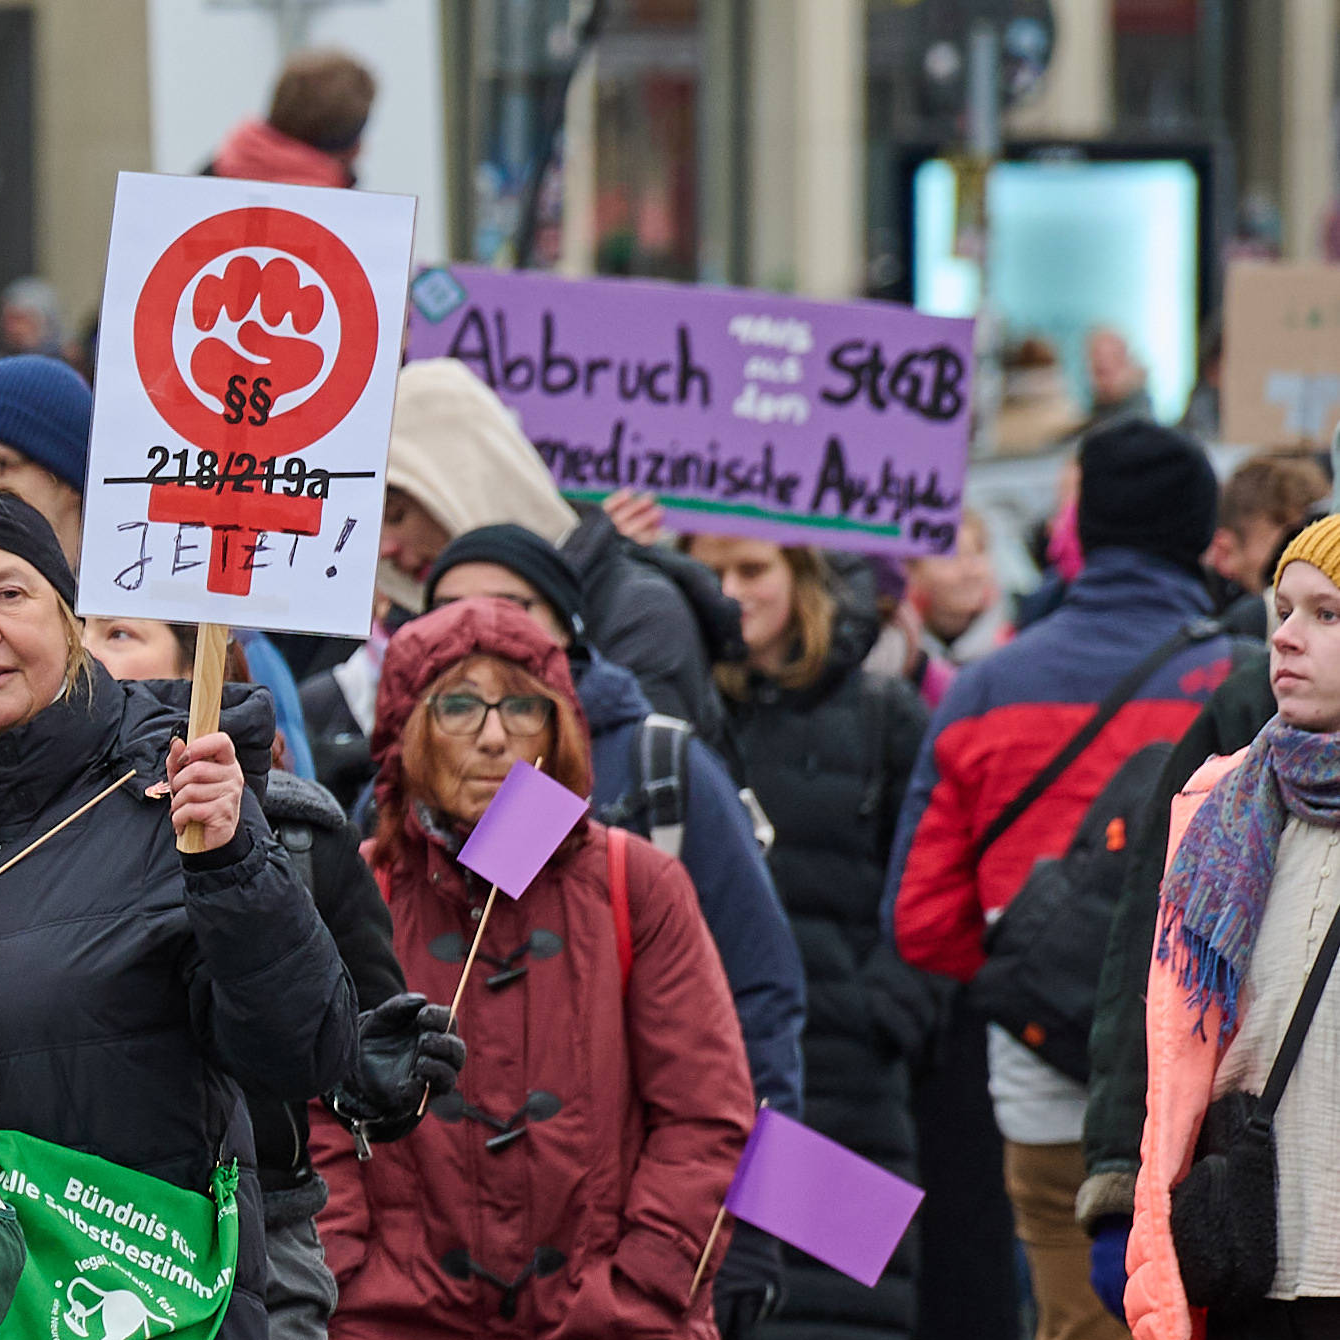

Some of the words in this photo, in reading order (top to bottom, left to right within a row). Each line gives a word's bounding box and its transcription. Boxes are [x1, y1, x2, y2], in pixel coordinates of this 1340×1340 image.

[448, 306, 712, 409] Abbruch
[819, 337, 966, 422] StGB
[63, 1176, 167, 1242] Bündnis
